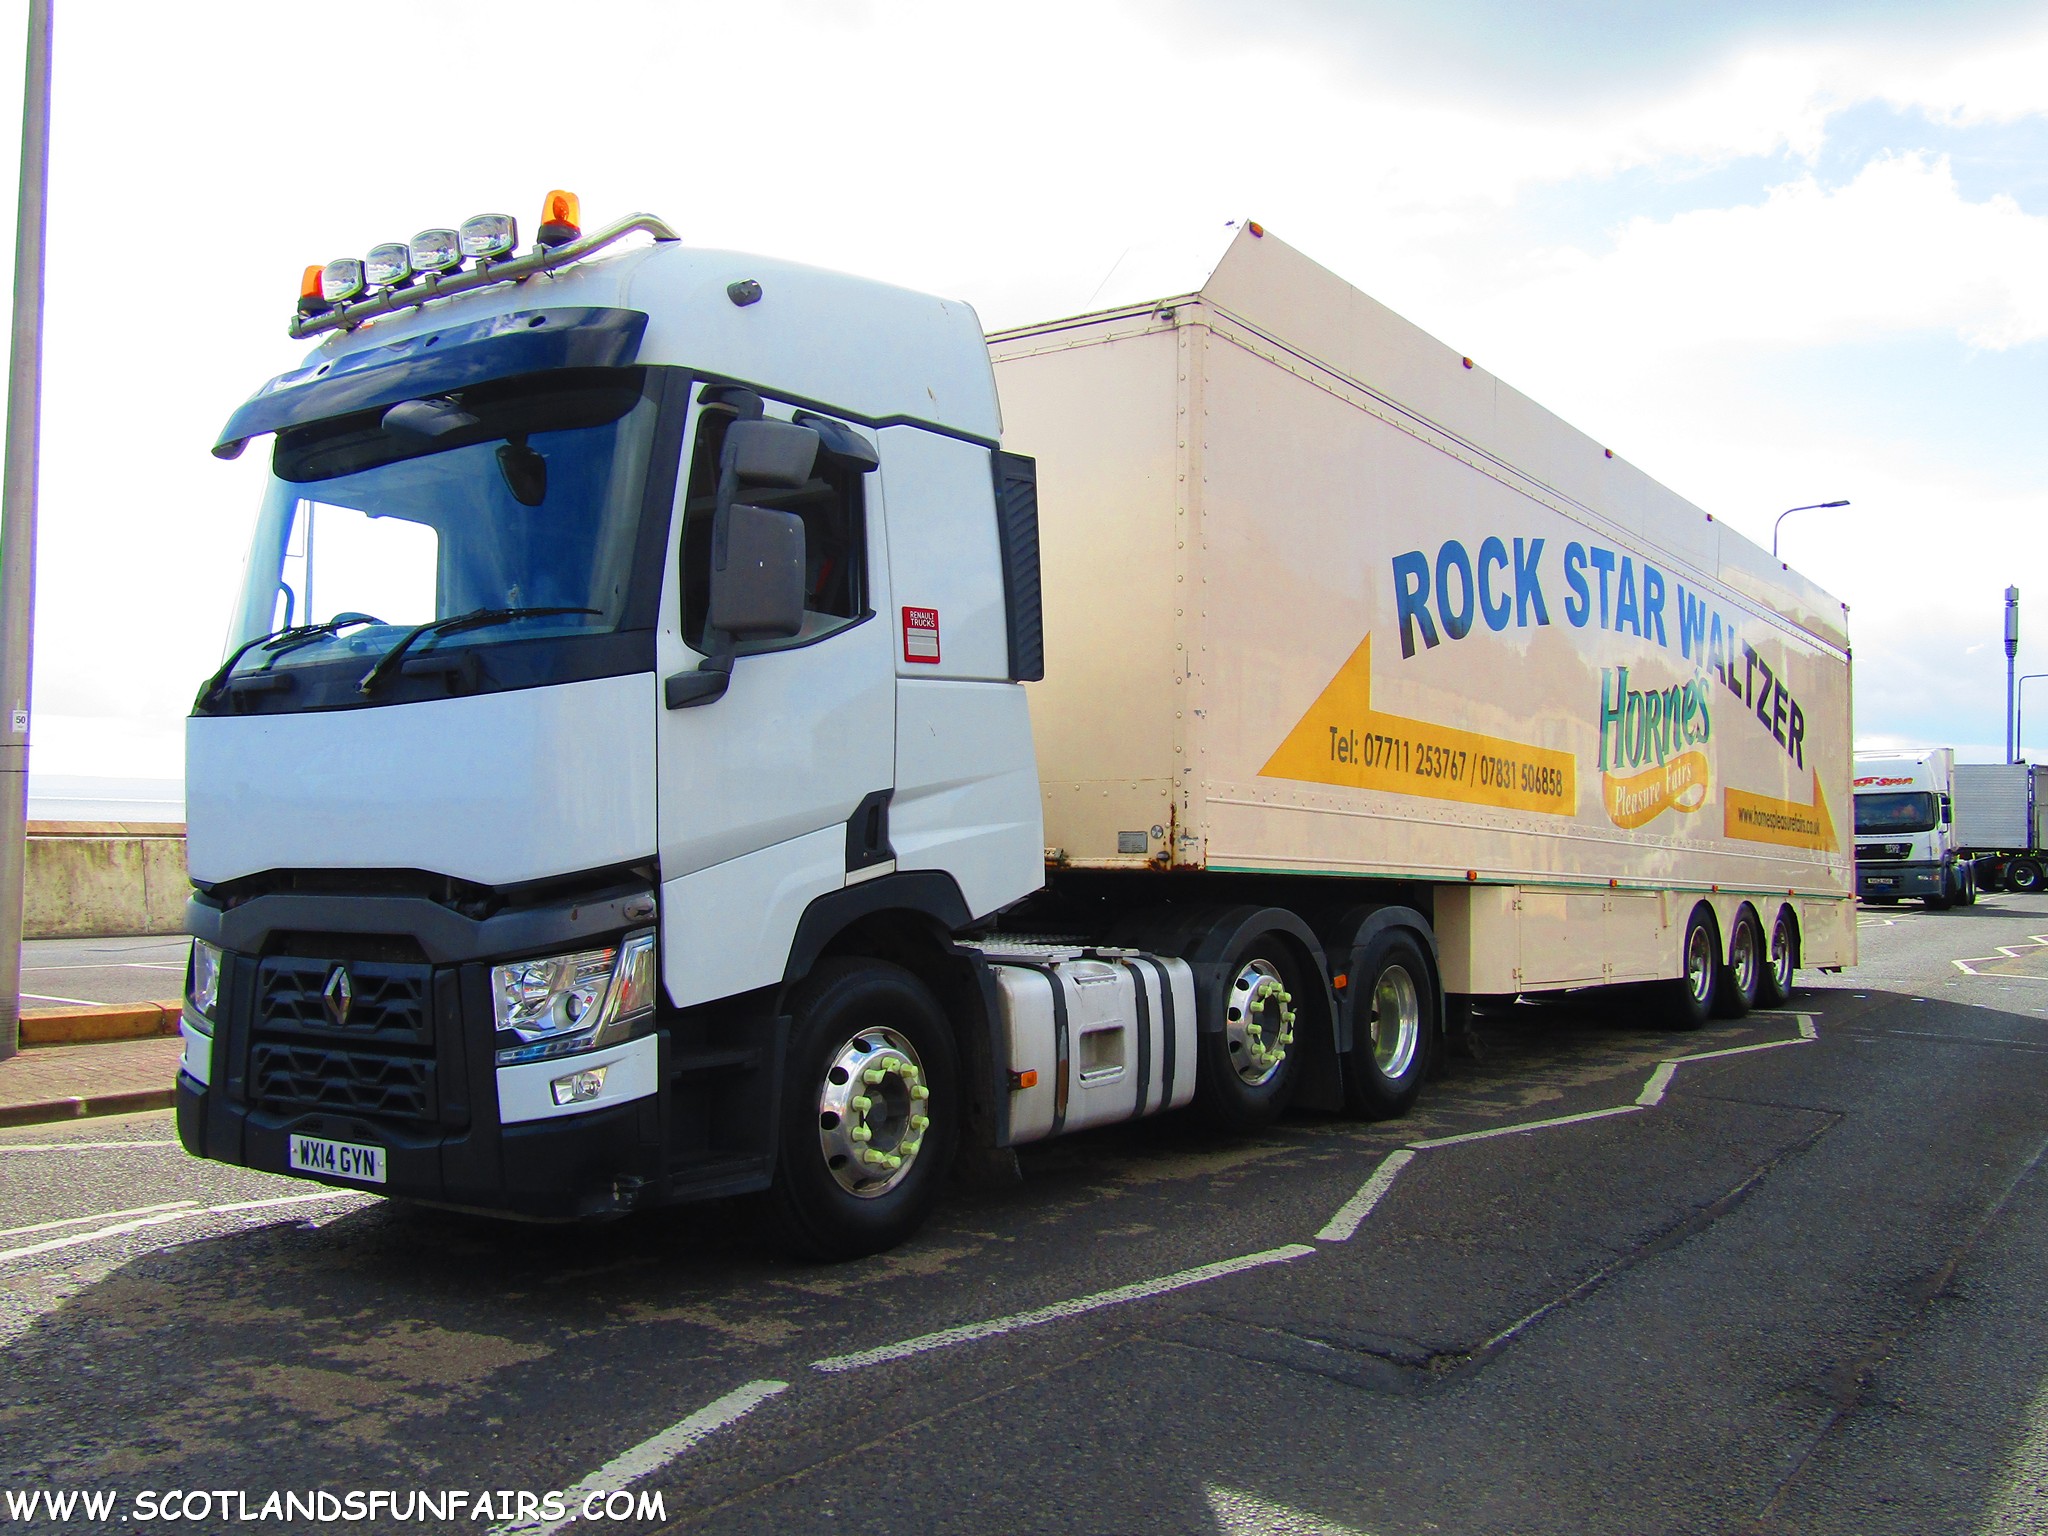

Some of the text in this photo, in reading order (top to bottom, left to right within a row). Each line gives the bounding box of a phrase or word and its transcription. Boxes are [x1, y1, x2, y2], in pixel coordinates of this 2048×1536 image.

[910, 611, 935, 620] RENAULT
[911, 619, 935, 627] TRUCKS
[1392, 536, 1805, 771] ROCK STAR WALTZER
[16, 716, 26, 724] 50
[1329, 725, 1563, 797] Tel: 07711 253767 / 07831 506858
[1614, 760, 1692, 817] Pleasure Fairs
[300, 1139, 375, 1176] WX14 GYN
